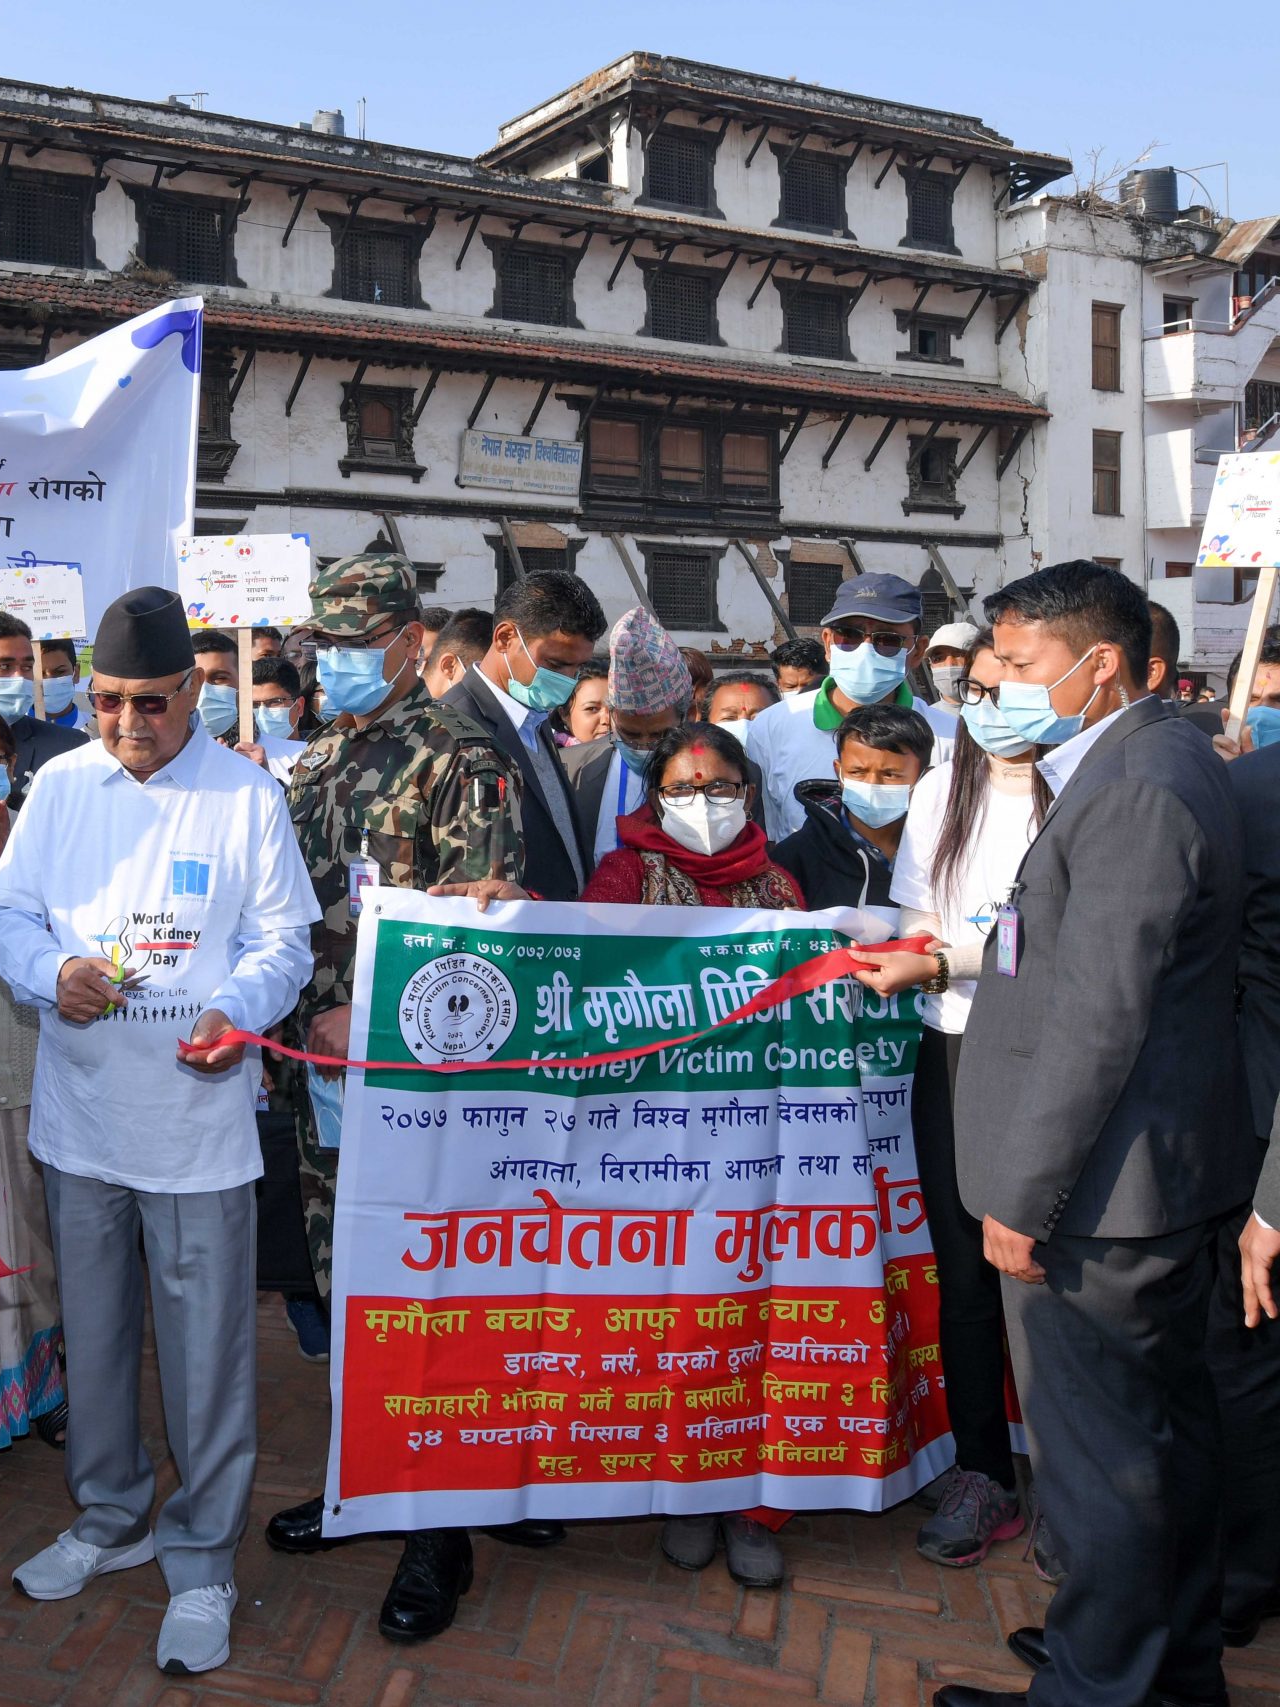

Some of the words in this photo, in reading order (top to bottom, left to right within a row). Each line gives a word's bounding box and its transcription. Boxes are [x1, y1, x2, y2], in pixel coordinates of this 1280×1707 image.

[28, 470, 106, 502] रोगको
[132, 912, 174, 925] World
[153, 927, 201, 943] Kidney
[403, 933, 435, 948] दर्ता
[152, 953, 178, 967] Day
[148, 989, 164, 999] for
[168, 987, 188, 997] Life
[425, 980, 450, 1003] Victim
[451, 975, 492, 1004] Concerned
[534, 970, 573, 1035] श्री
[582, 969, 696, 1044] मृगौला
[423, 1006, 436, 1040] Kidney
[475, 1007, 494, 1039] Society
[442, 1041, 467, 1051] Nepal
[527, 1050, 647, 1084] Kidney
[658, 1045, 753, 1075] Victim
[381, 1105, 448, 1131] २०७७
[462, 1107, 528, 1137] फागुन
[544, 1109, 576, 1133] २७
[588, 1103, 620, 1130] गते
[633, 1099, 690, 1129] विश्व
[702, 1097, 770, 1136] मृगौला
[777, 1094, 858, 1124] दिवसको
[600, 1152, 711, 1183] विरामीका
[799, 1154, 841, 1176] तथा
[401, 1188, 694, 1272] जनचेतना
[364, 1301, 471, 1343] मृगौला
[605, 1307, 681, 1340] आफु
[695, 1297, 748, 1330] पनि
[657, 1345, 719, 1375] घरको
[727, 1340, 764, 1374] ठुलो
[771, 1335, 870, 1365] व्यक्तिको
[383, 1387, 491, 1419] साकाहारी
[501, 1387, 568, 1413] भोजन
[579, 1387, 615, 1413] गर्ने
[625, 1384, 675, 1412] बानी
[761, 1371, 831, 1403] दिनमा
[841, 1383, 854, 1407] ३
[407, 1429, 443, 1452] २४
[459, 1418, 557, 1446] घण्टाको
[569, 1420, 643, 1444] पिसाब
[654, 1423, 669, 1443] ३
[686, 1413, 771, 1440] महिनामा
[783, 1415, 827, 1437] एक
[838, 1416, 892, 1436] पटक
[600, 1452, 656, 1475] सुगर
[668, 1454, 688, 1473] र
[698, 1447, 747, 1471] प्रेसर
[756, 1440, 848, 1463] अनिवार्य
